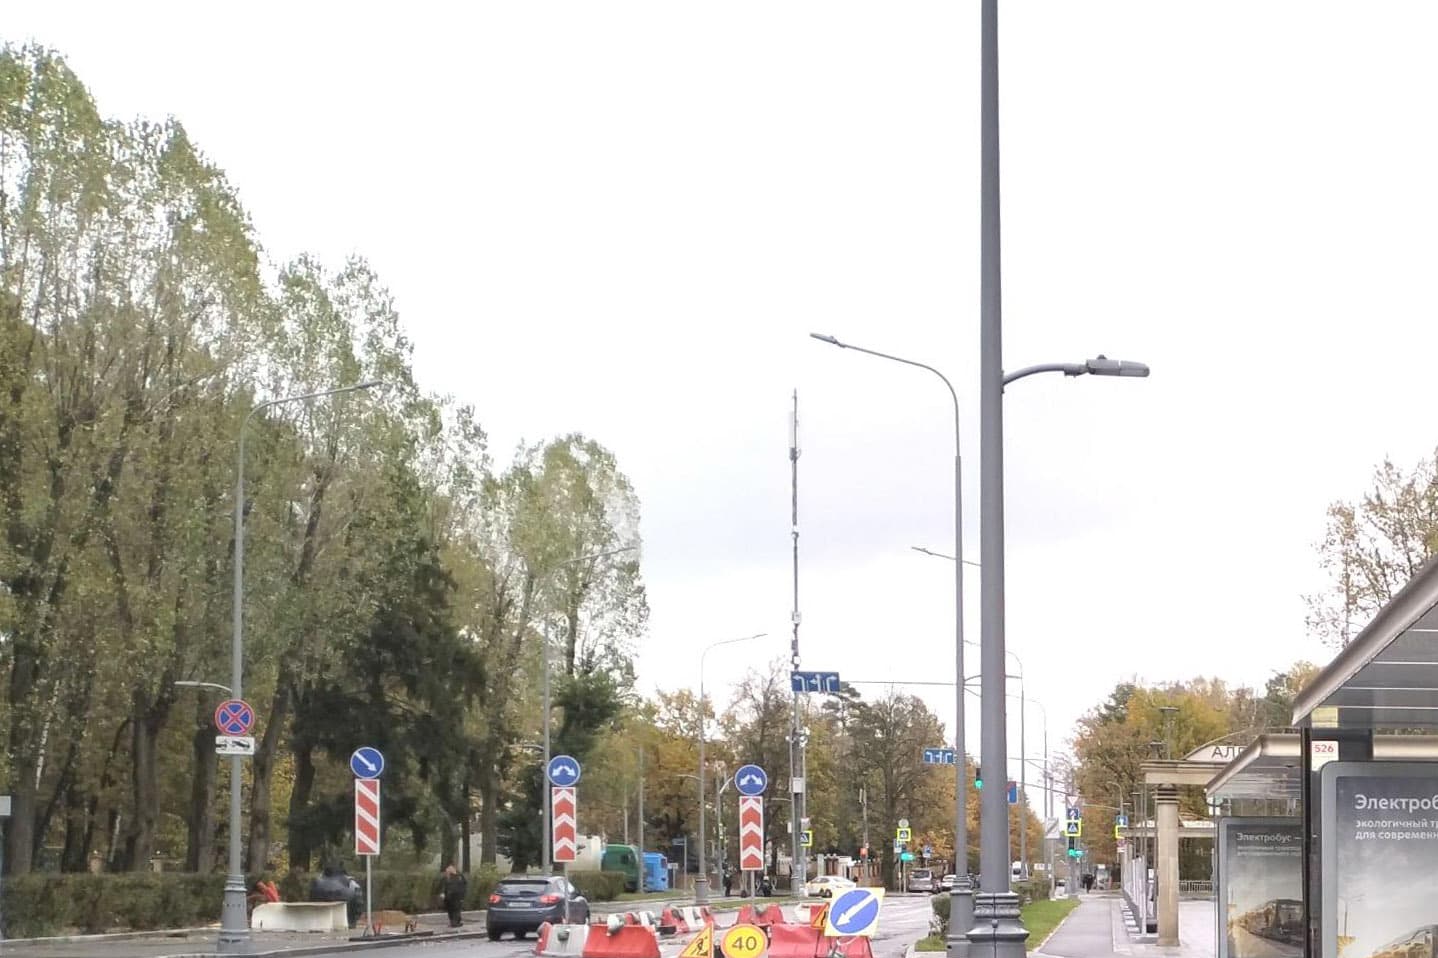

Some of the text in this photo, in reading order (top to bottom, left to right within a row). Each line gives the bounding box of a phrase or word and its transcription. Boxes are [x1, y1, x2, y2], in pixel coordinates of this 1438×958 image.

[1314, 744, 1334, 753] 526
[1355, 818, 1428, 828] экологичный
[1236, 832, 1292, 844] Электробус
[1355, 831, 1376, 841] для
[731, 936, 757, 951] 40
